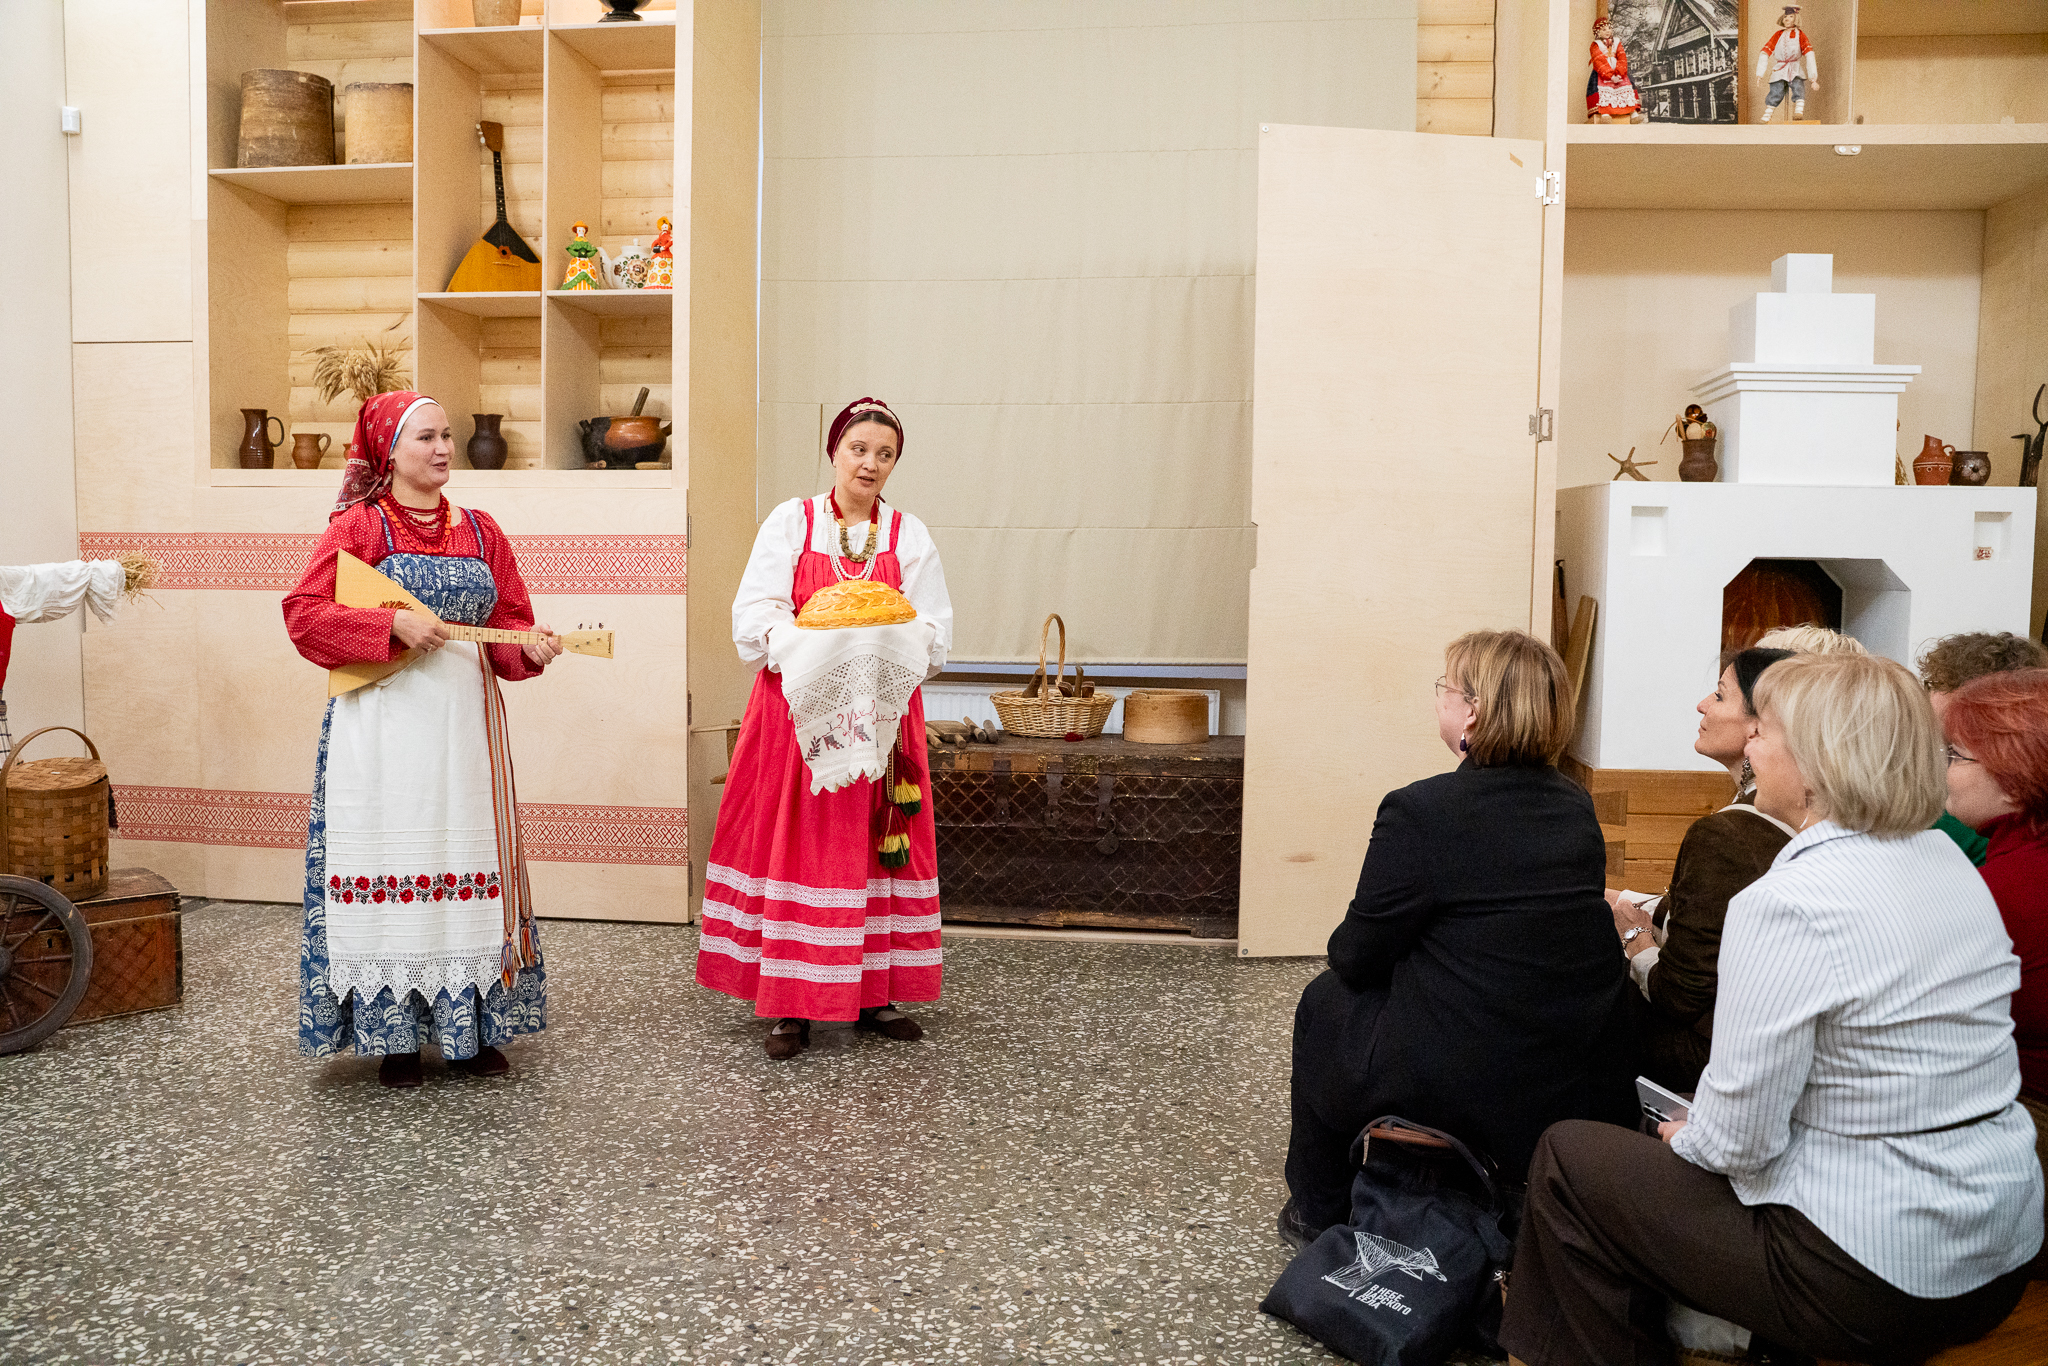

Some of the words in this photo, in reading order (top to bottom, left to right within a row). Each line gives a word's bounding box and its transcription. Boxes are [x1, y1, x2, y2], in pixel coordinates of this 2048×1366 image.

[1355, 1294, 1381, 1309] СЕЛА
[1363, 1289, 1412, 1315] ЦАРСКОГО
[1370, 1284, 1380, 1292] В
[1377, 1287, 1405, 1303] НЕБЕ
